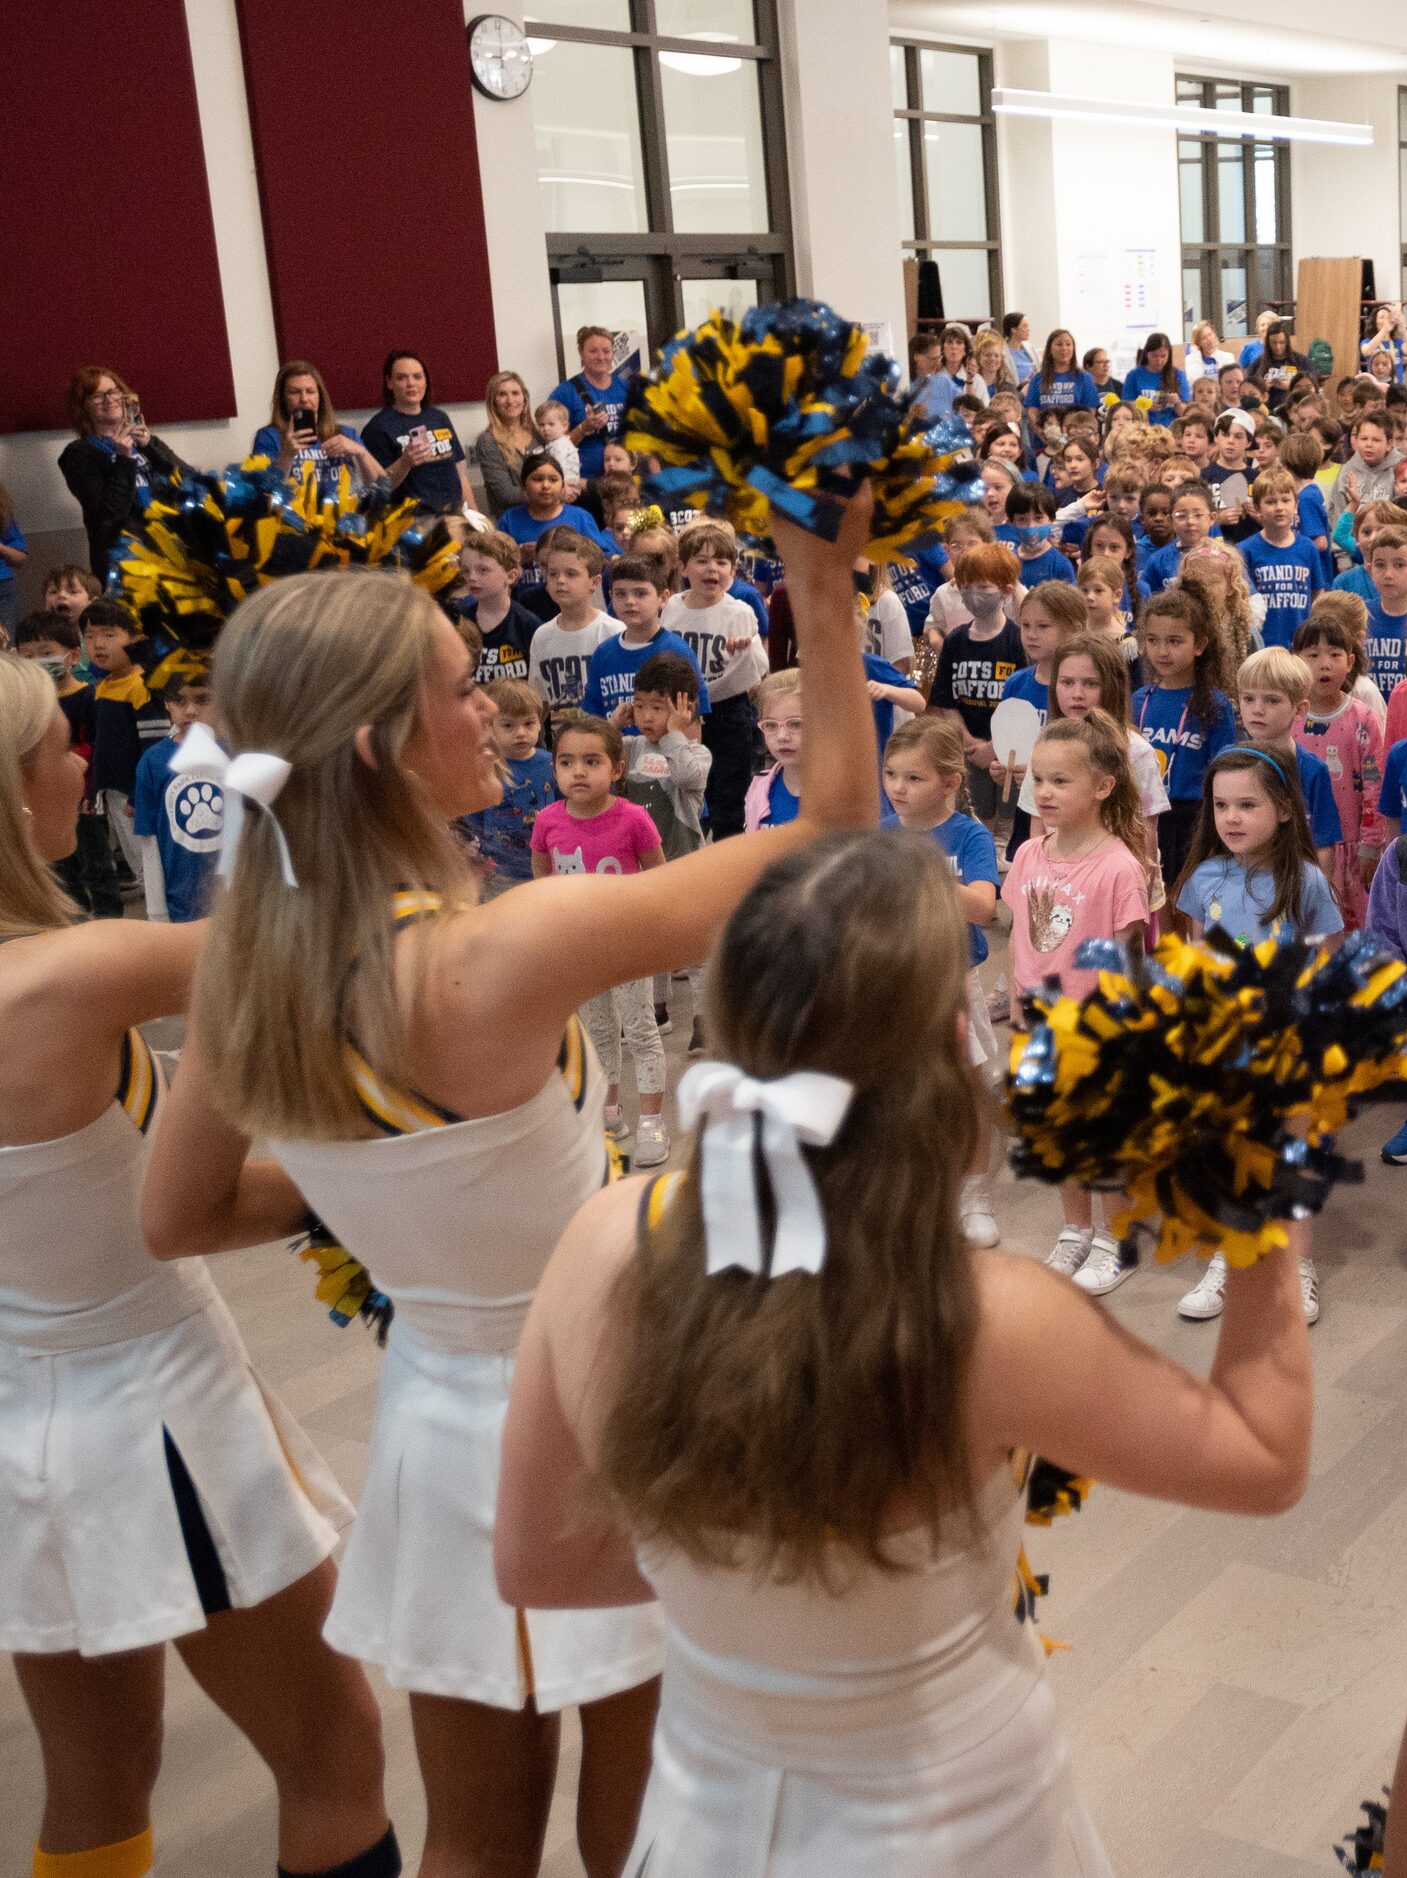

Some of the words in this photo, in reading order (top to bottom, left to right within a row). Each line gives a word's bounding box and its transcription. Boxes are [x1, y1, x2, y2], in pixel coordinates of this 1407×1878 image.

[1254, 565, 1294, 583] STAND
[1294, 565, 1310, 582] UP
[1275, 582, 1293, 591] FOR
[1365, 638, 1402, 657] TAND
[1378, 660, 1399, 670] FOR
